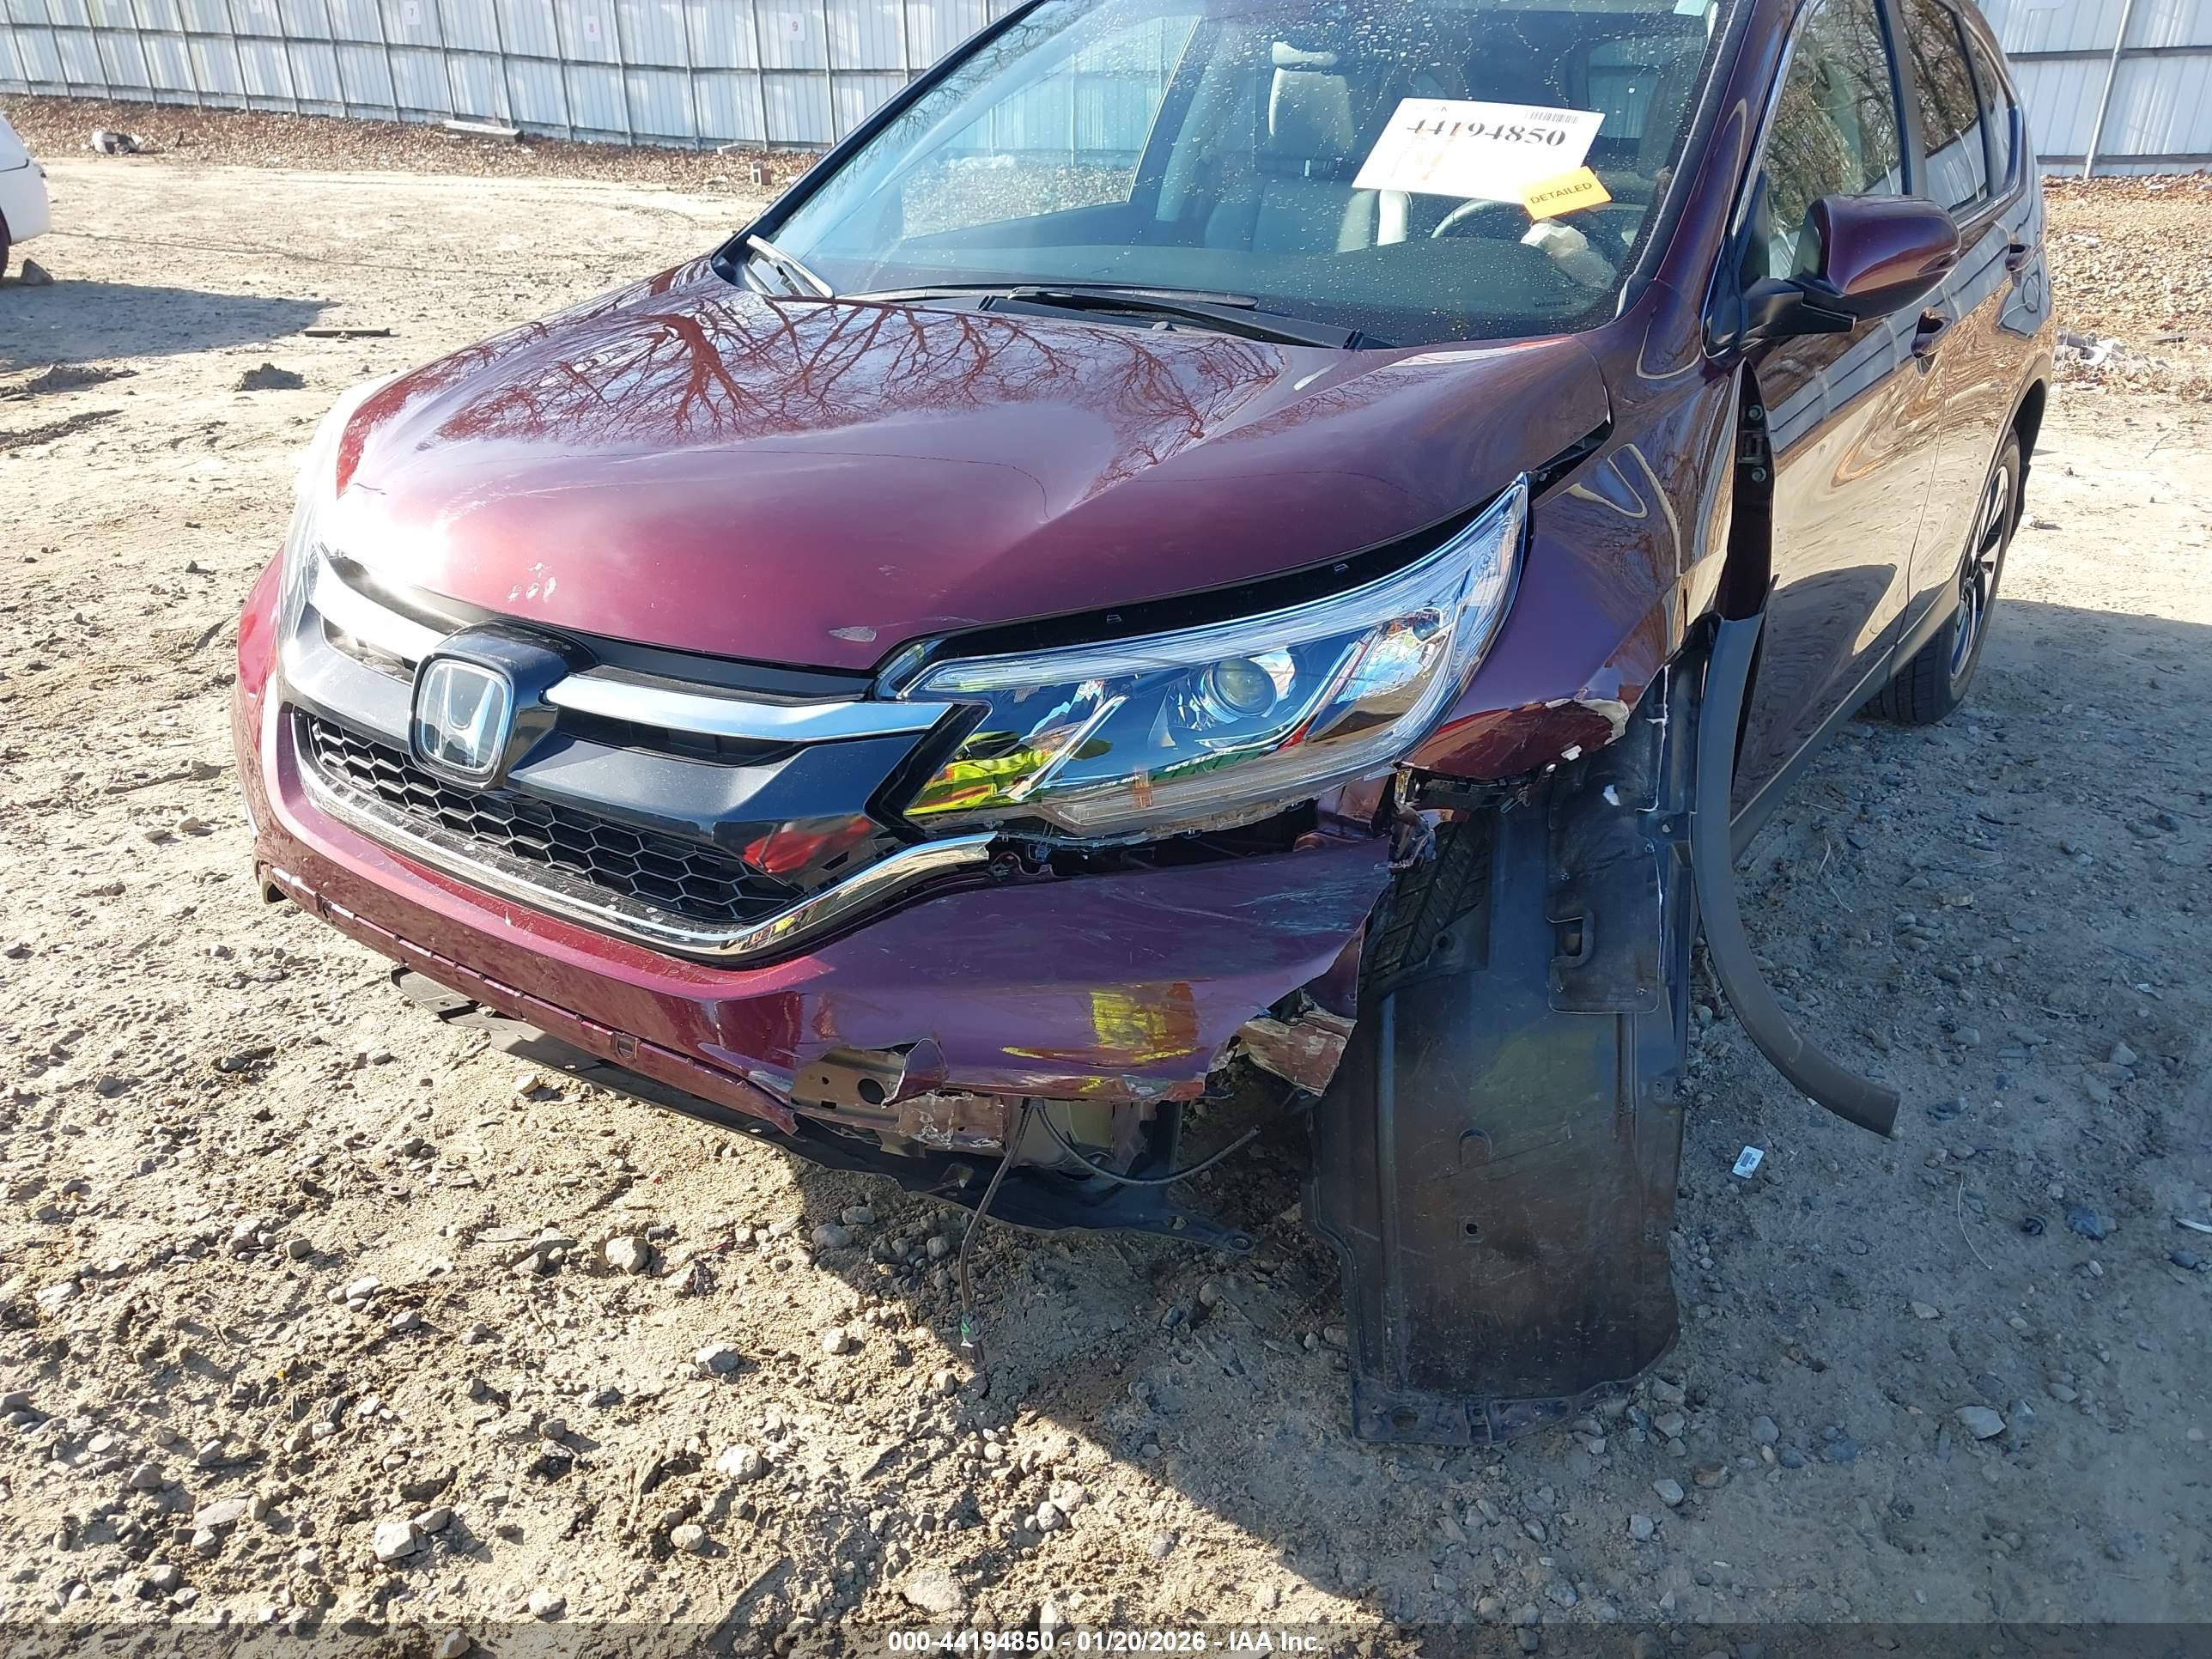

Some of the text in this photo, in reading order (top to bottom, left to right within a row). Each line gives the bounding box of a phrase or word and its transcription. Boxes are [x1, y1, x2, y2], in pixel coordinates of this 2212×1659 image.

[792, 21, 799, 32] 9
[1406, 119, 1566, 146] 44194850
[1529, 182, 1593, 204] DETAILED
